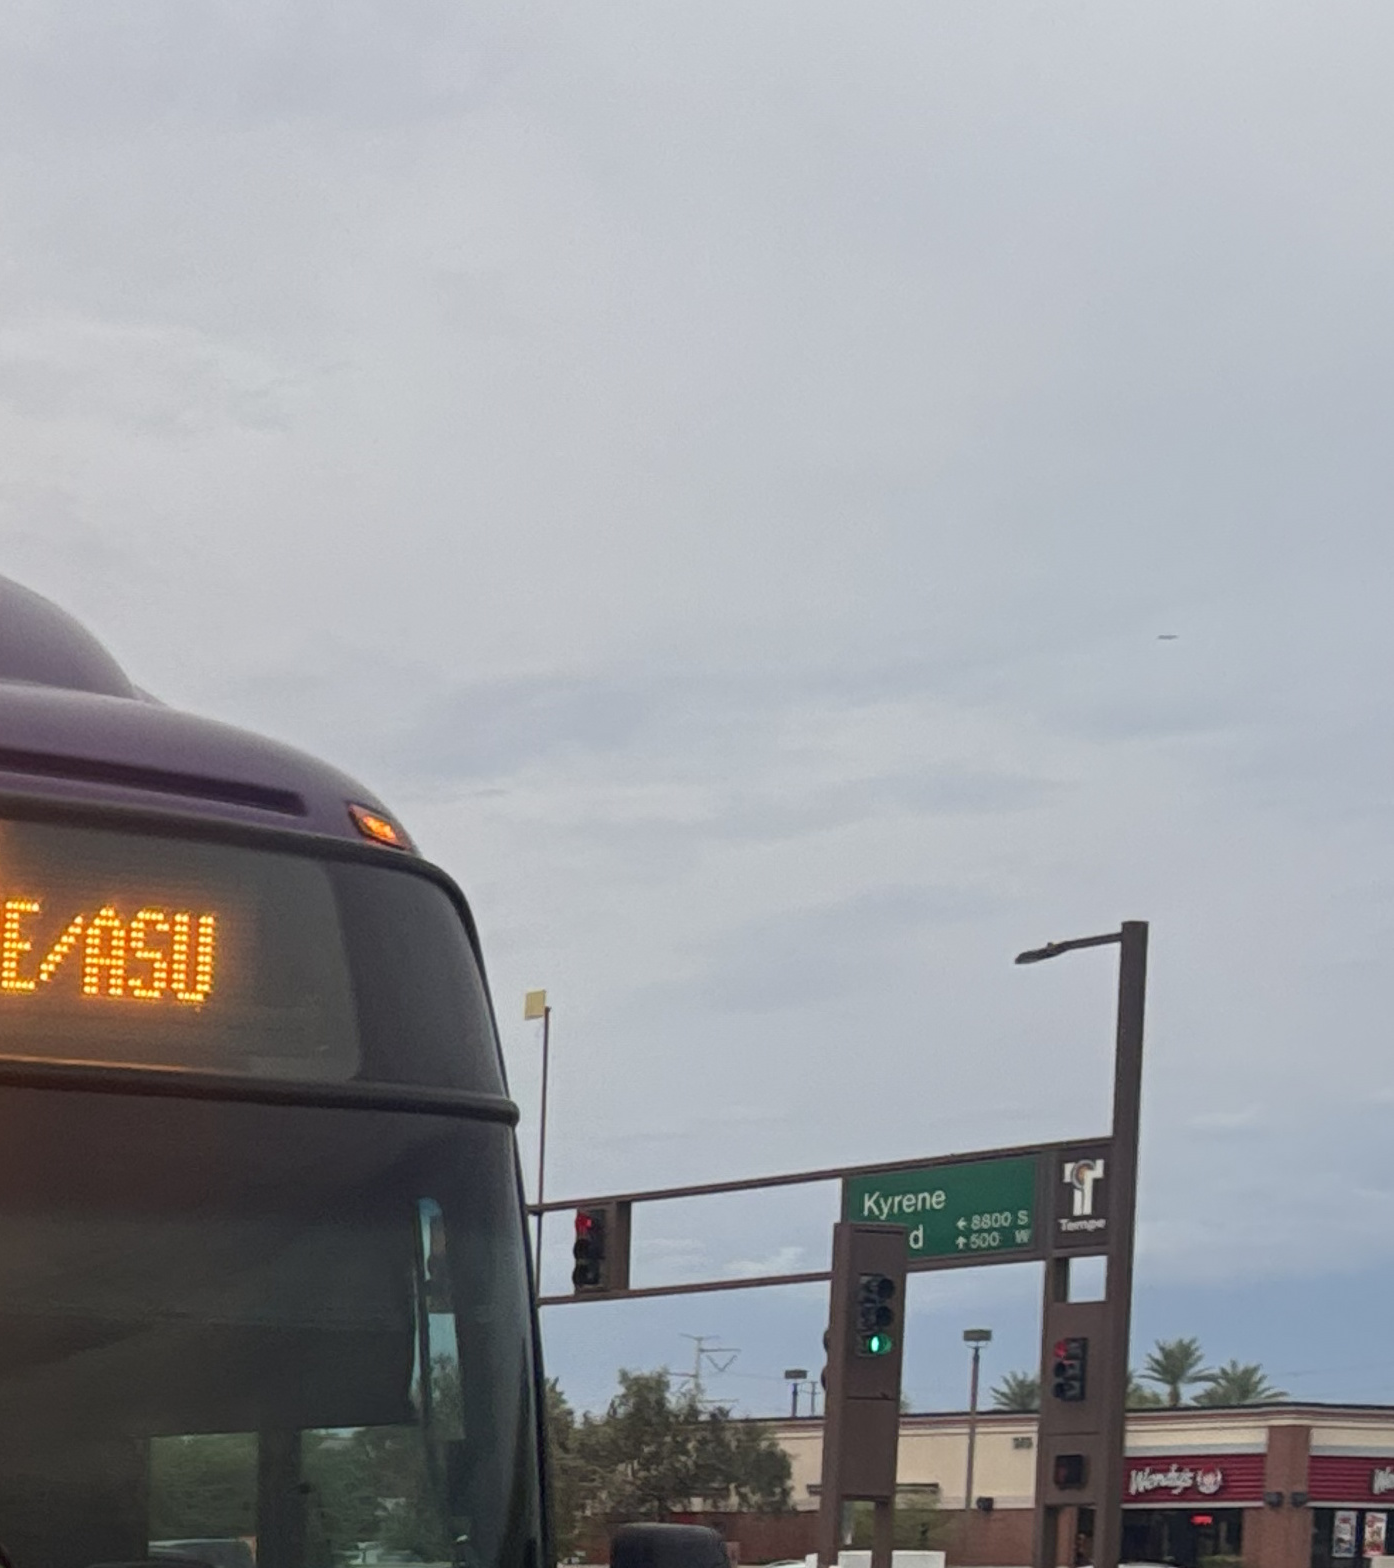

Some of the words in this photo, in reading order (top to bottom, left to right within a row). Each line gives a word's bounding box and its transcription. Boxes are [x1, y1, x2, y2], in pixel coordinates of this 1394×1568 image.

[863, 1189, 947, 1220] Kyrene
[971, 1211, 1012, 1229] 8800
[1017, 1210, 1029, 1226] S
[1058, 1218, 1106, 1234] Tempe
[969, 1232, 1000, 1249] 500
[1015, 1230, 1032, 1244] W
[1129, 1463, 1194, 1496] Wendy's
